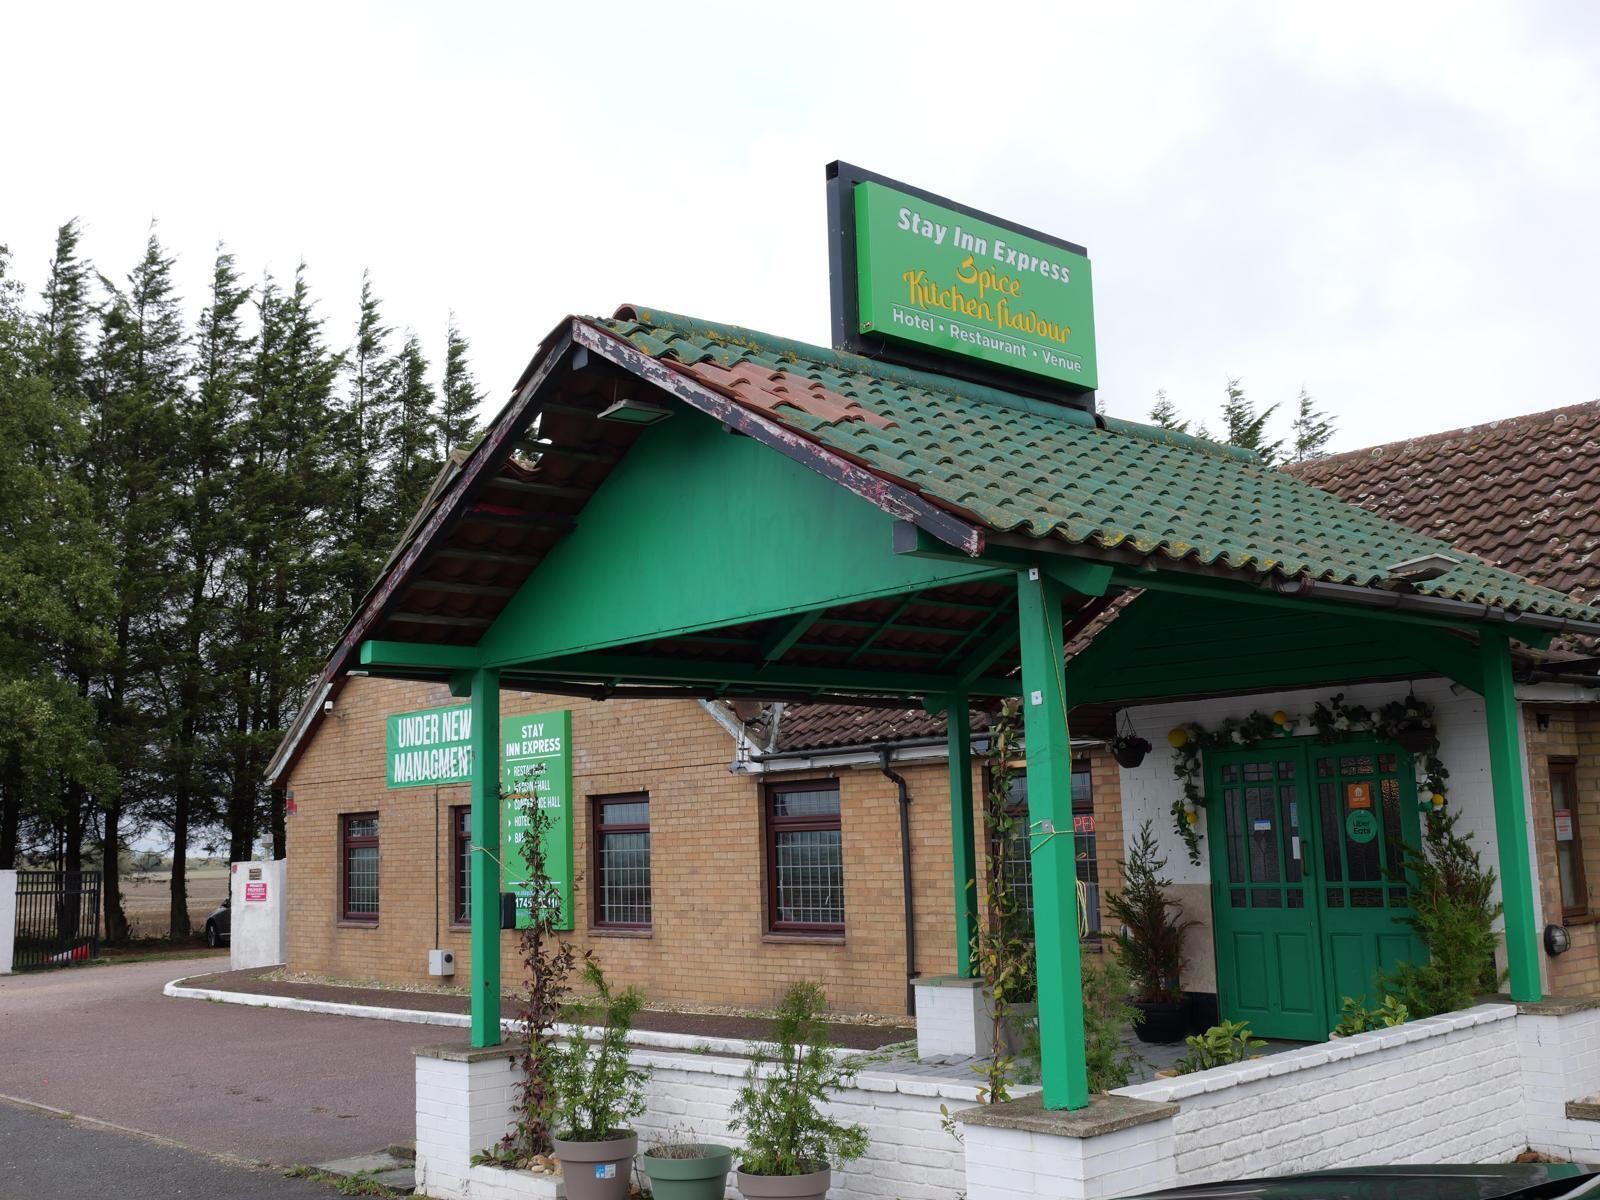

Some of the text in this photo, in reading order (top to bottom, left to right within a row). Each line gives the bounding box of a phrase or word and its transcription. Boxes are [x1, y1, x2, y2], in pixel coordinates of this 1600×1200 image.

[897, 207, 1071, 283] Stay Inn Express
[956, 256, 1022, 298] Spice
[903, 270, 993, 321] Kitchen
[892, 309, 1081, 373] Hotel Restaurant Venue
[398, 708, 472, 748] UNDER NEW
[521, 723, 544, 738] STAY
[506, 738, 560, 756] INN EXPRESS
[537, 780, 551, 791] HALL
[547, 796, 561, 808] HALL
[514, 815, 531, 827] HOTEL
[1073, 816, 1095, 832] PEN
